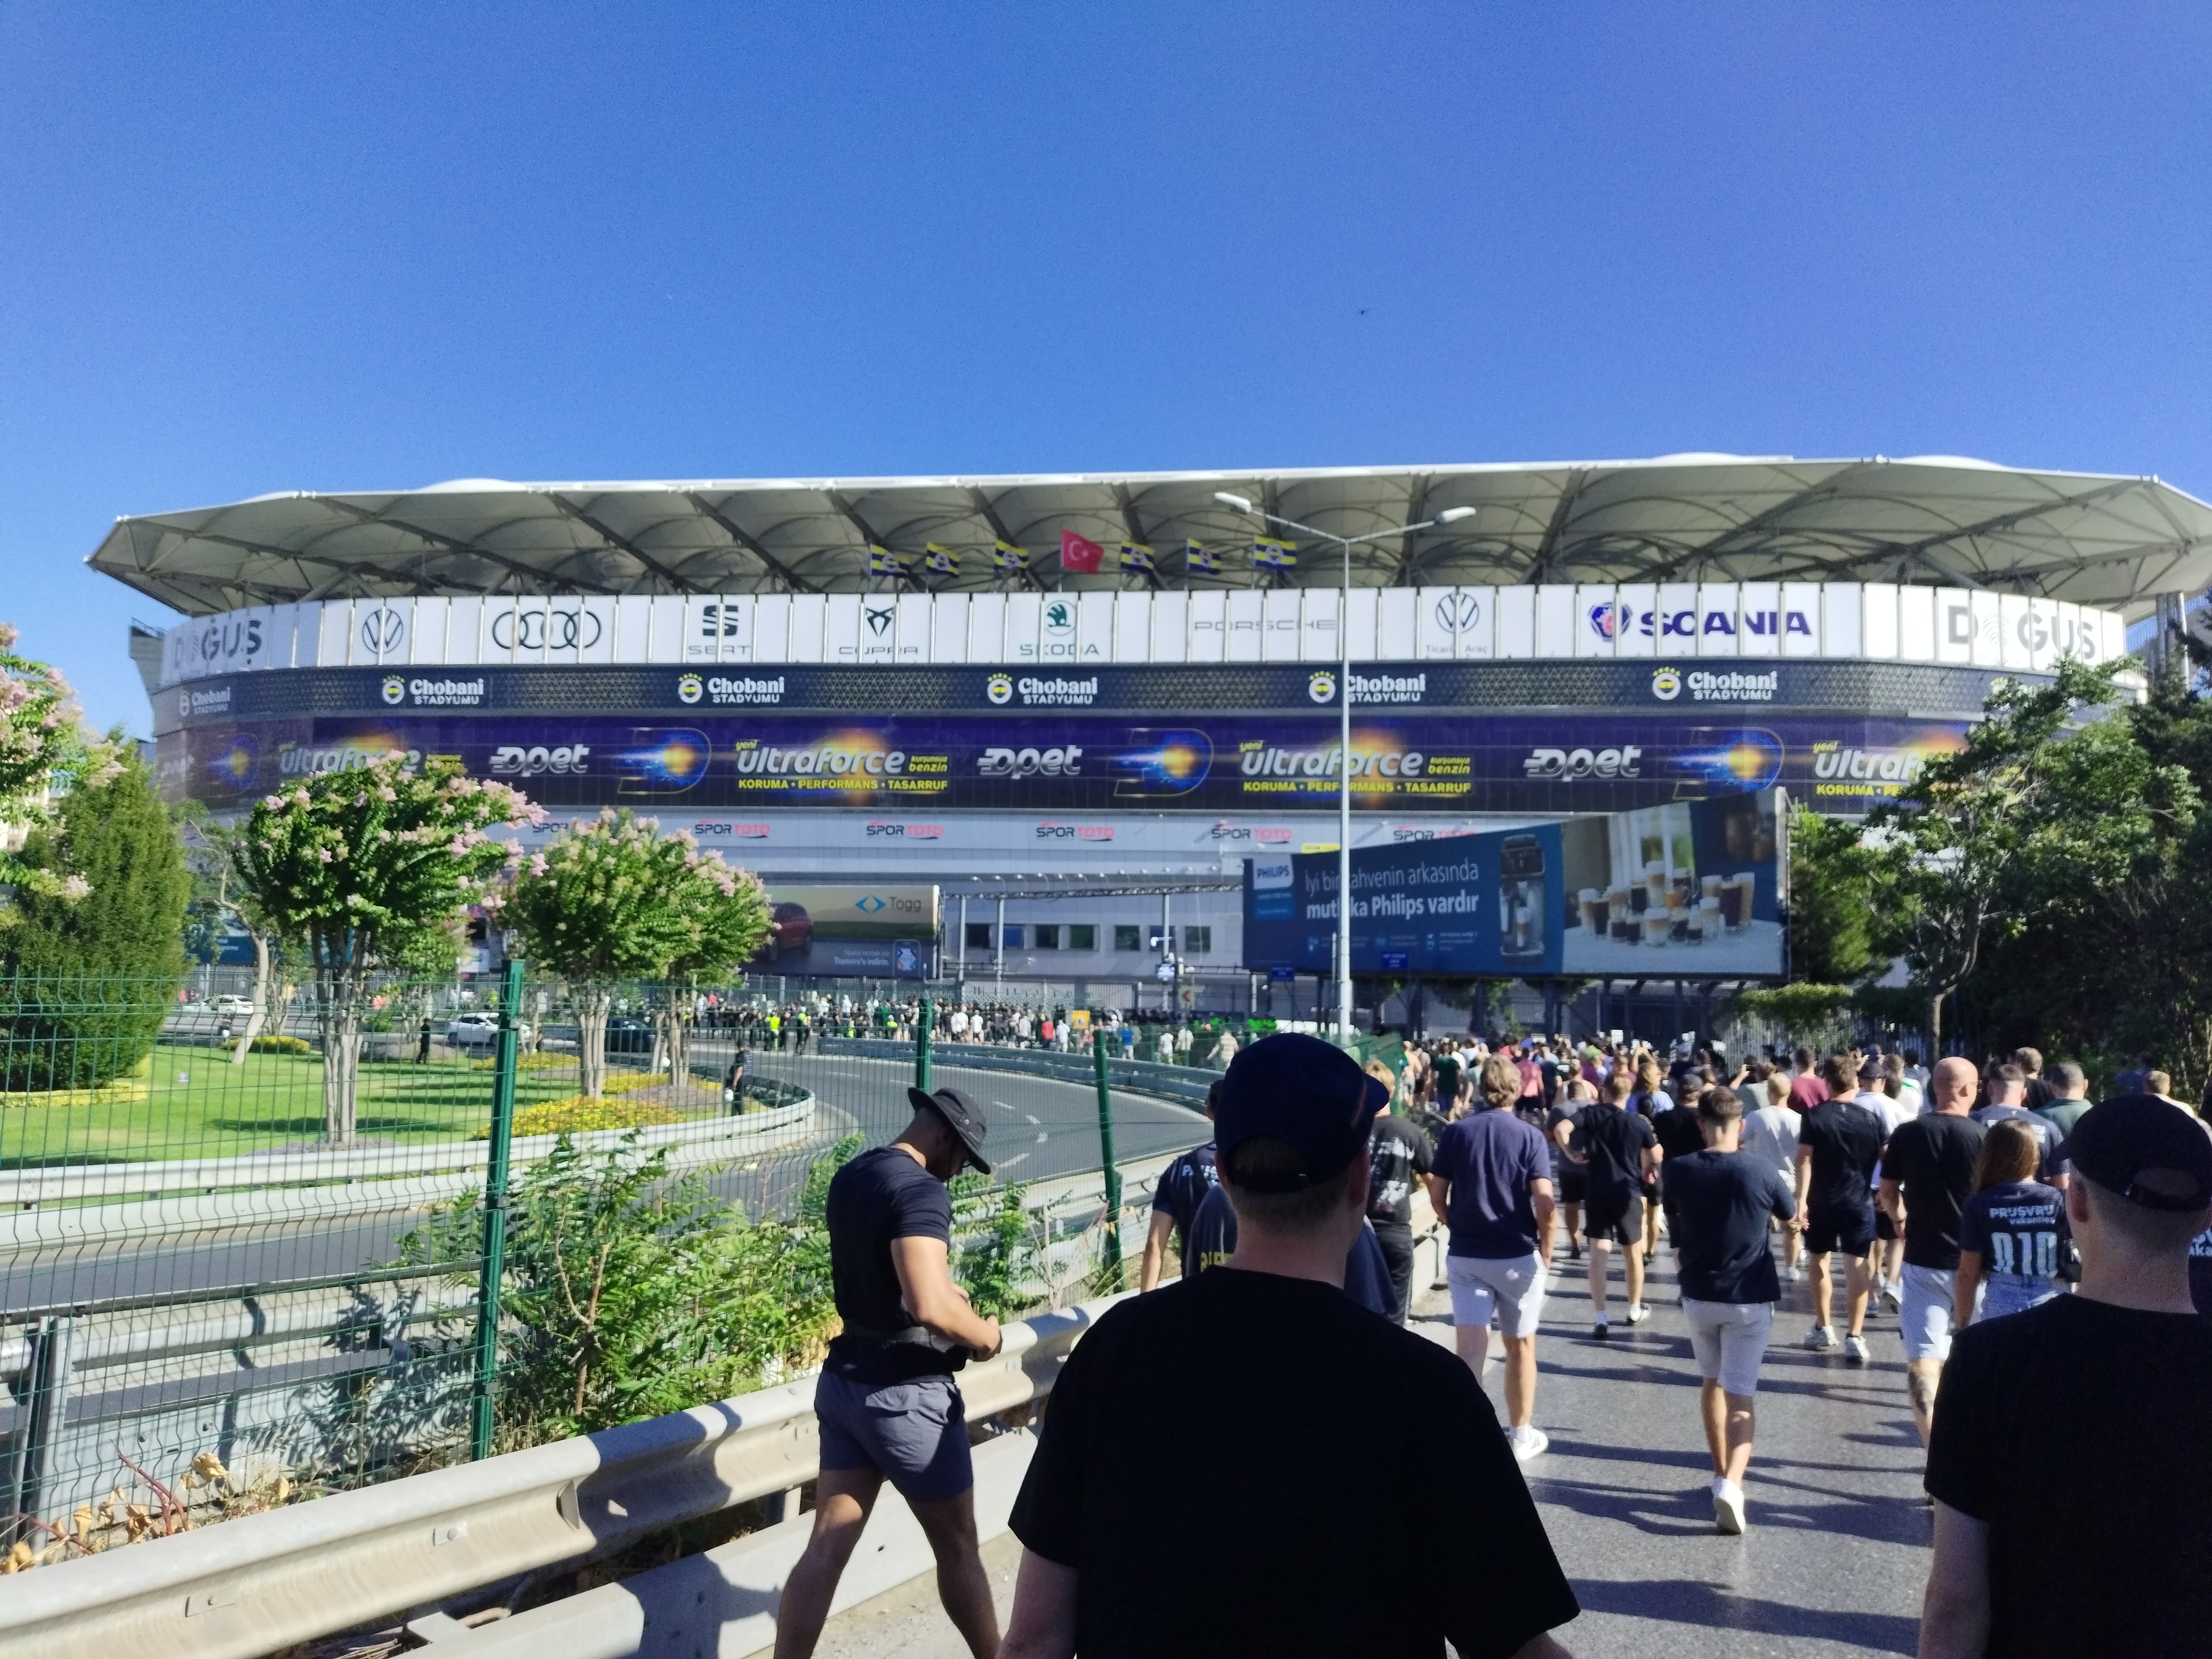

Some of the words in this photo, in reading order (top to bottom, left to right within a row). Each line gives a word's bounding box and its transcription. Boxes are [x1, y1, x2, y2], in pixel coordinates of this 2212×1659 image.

[1640, 609, 1812, 636] SCANIA
[688, 645, 751, 654] SEAT
[708, 676, 784, 694] Chobani
[1018, 676, 1098, 694] Chobani
[1348, 673, 1426, 692] Chobani
[1688, 671, 1777, 690] Chobani
[410, 678, 484, 695] Chobani
[413, 695, 480, 705] STADYUMU
[712, 694, 780, 704] STADYUMU
[1023, 695, 1094, 705] STADYUMU
[1348, 692, 1421, 703] STADYUMU
[1694, 690, 1773, 700] STADYUMU
[737, 746, 905, 775] ultraforce
[909, 762, 948, 772] benzin
[1428, 764, 1470, 774] benzin
[738, 779, 788, 790] KORUMA
[798, 779, 878, 790] PERFORMANS
[888, 780, 948, 790] TASARRUF
[1243, 781, 1296, 793] KORUMA
[1307, 781, 1394, 793] PERFRMANS
[1405, 782, 1471, 793] TASARRUF
[1816, 784, 1874, 796] KORUMA
[696, 824, 731, 835] SPOR
[734, 824, 770, 835] TOTO
[867, 825, 904, 836] SPOR
[906, 825, 943, 836] TOTO
[1036, 827, 1075, 838] SPOR
[1077, 827, 1115, 838] TOTO
[1212, 829, 1251, 839] SPOR
[1253, 828, 1292, 840] TOTO
[1394, 830, 1434, 841] SPOR
[1349, 865, 1405, 889] ahvenin
[1408, 857, 1479, 884] arkasında
[890, 896, 921, 913] Togg
[1306, 895, 1368, 919] mutlka
[1372, 893, 1424, 921] Philips
[1428, 889, 1479, 914] vardır
